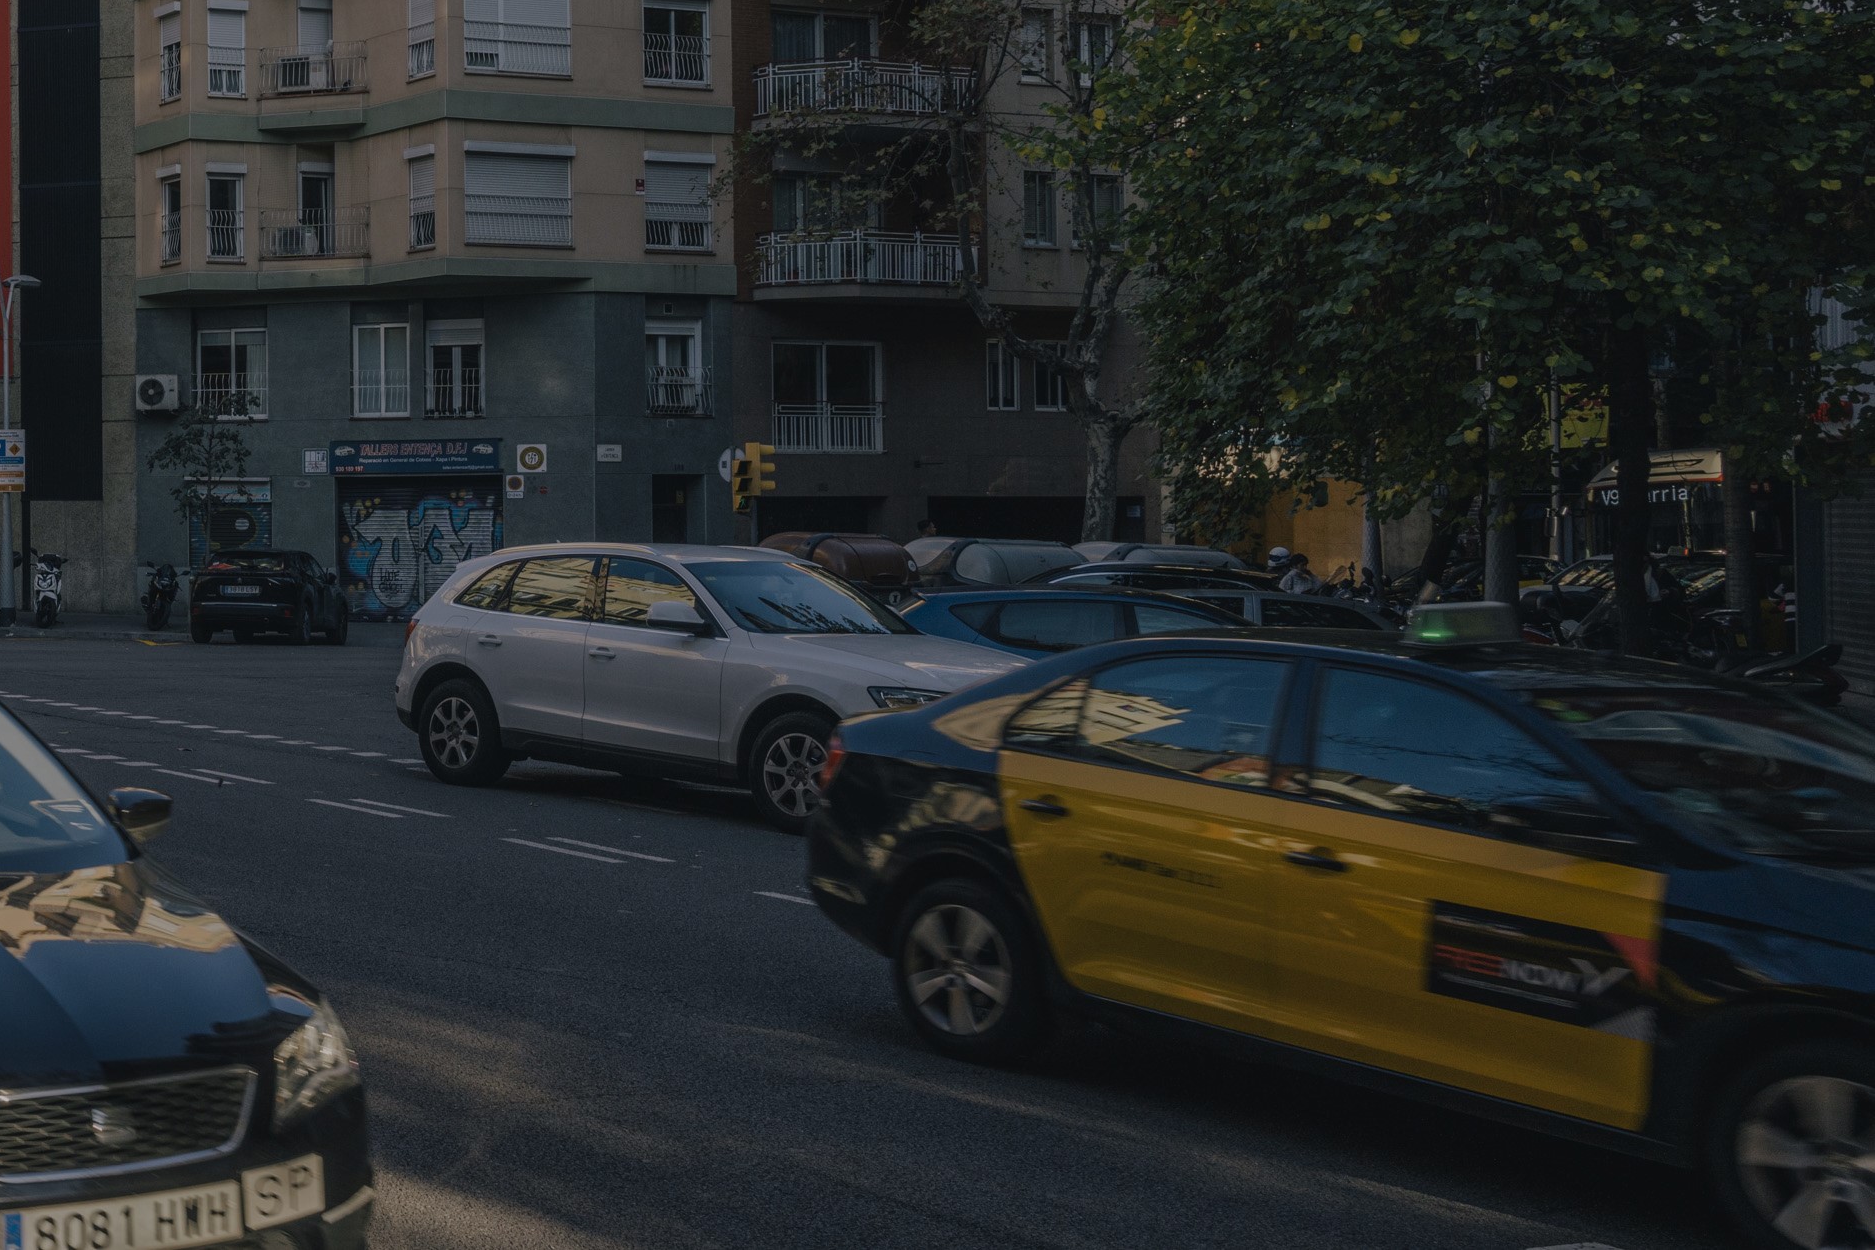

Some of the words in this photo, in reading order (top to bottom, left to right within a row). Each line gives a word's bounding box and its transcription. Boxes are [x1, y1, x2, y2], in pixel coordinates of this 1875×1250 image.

[359, 443, 399, 456] TALLERS
[1601, 489, 1619, 506] V9
[254, 1164, 313, 1218] SP
[35, 1206, 134, 1250] 8081
